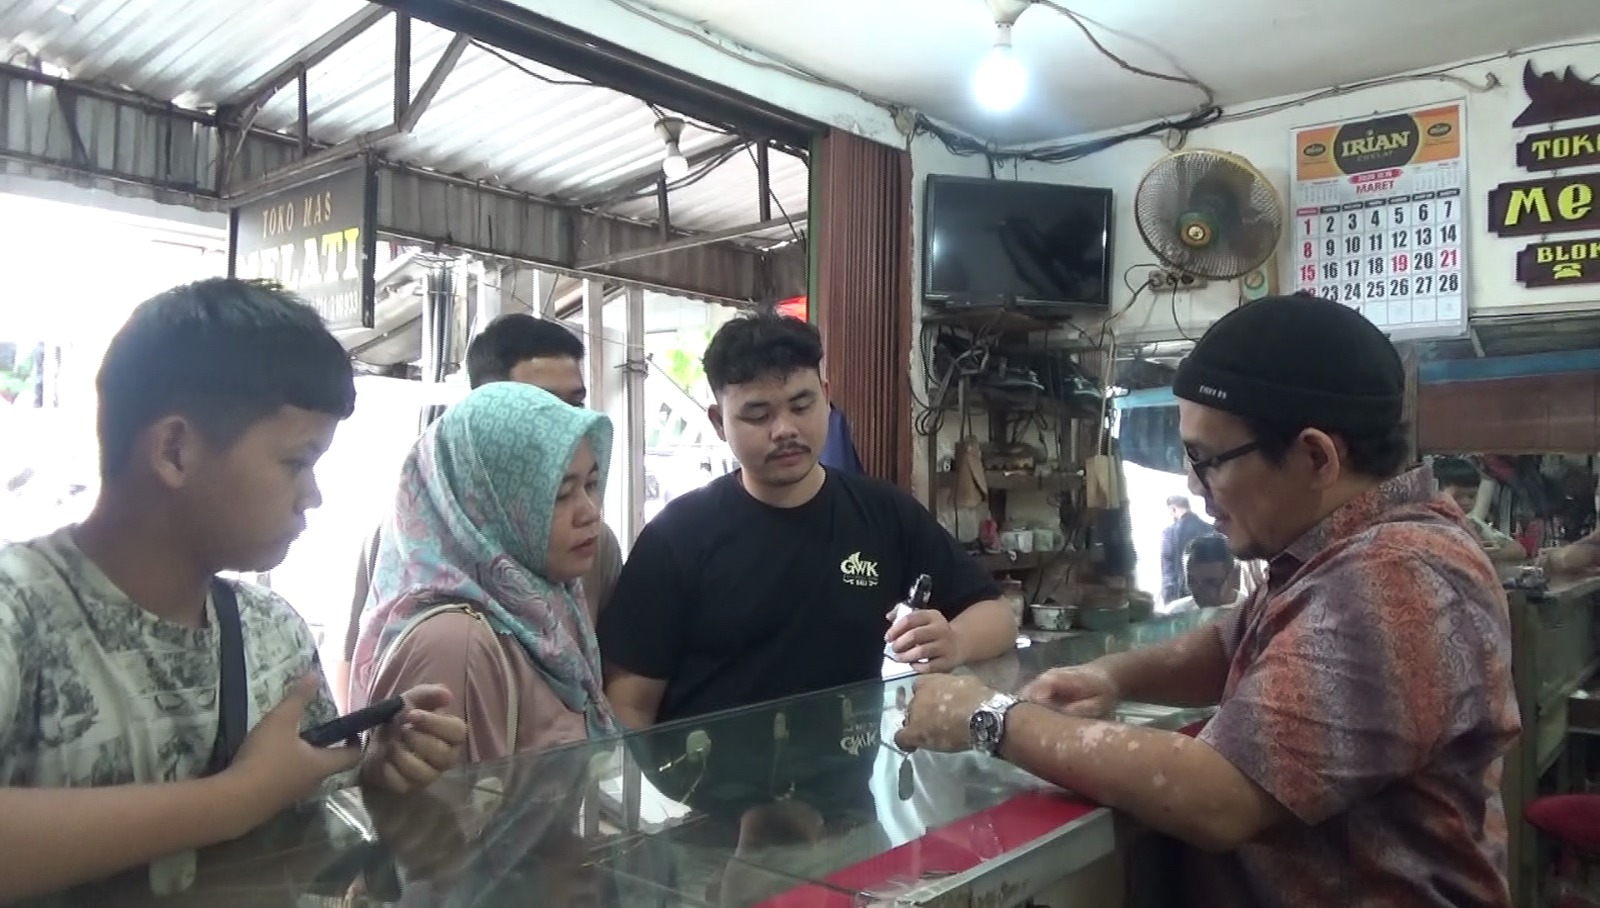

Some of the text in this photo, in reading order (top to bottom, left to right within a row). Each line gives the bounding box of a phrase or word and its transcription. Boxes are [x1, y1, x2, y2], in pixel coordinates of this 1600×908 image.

[1531, 134, 1600, 160] TOK
[1356, 181, 1394, 194] MARET
[262, 191, 331, 238] TOKO MAS
[1305, 202, 1452, 234] 1 2 3 4 5 6 7
[1304, 225, 1456, 258] 8 9 10 11 12 13 14
[1301, 250, 1456, 281] 15 16 17 18 19 20 21
[1322, 285, 1338, 301] 23
[1345, 283, 1360, 300] 24
[1367, 281, 1384, 298] 25
[1390, 279, 1408, 295] 26
[1416, 276, 1432, 294] 27
[1439, 273, 1458, 292] 28
[840, 551, 879, 577] GWK
